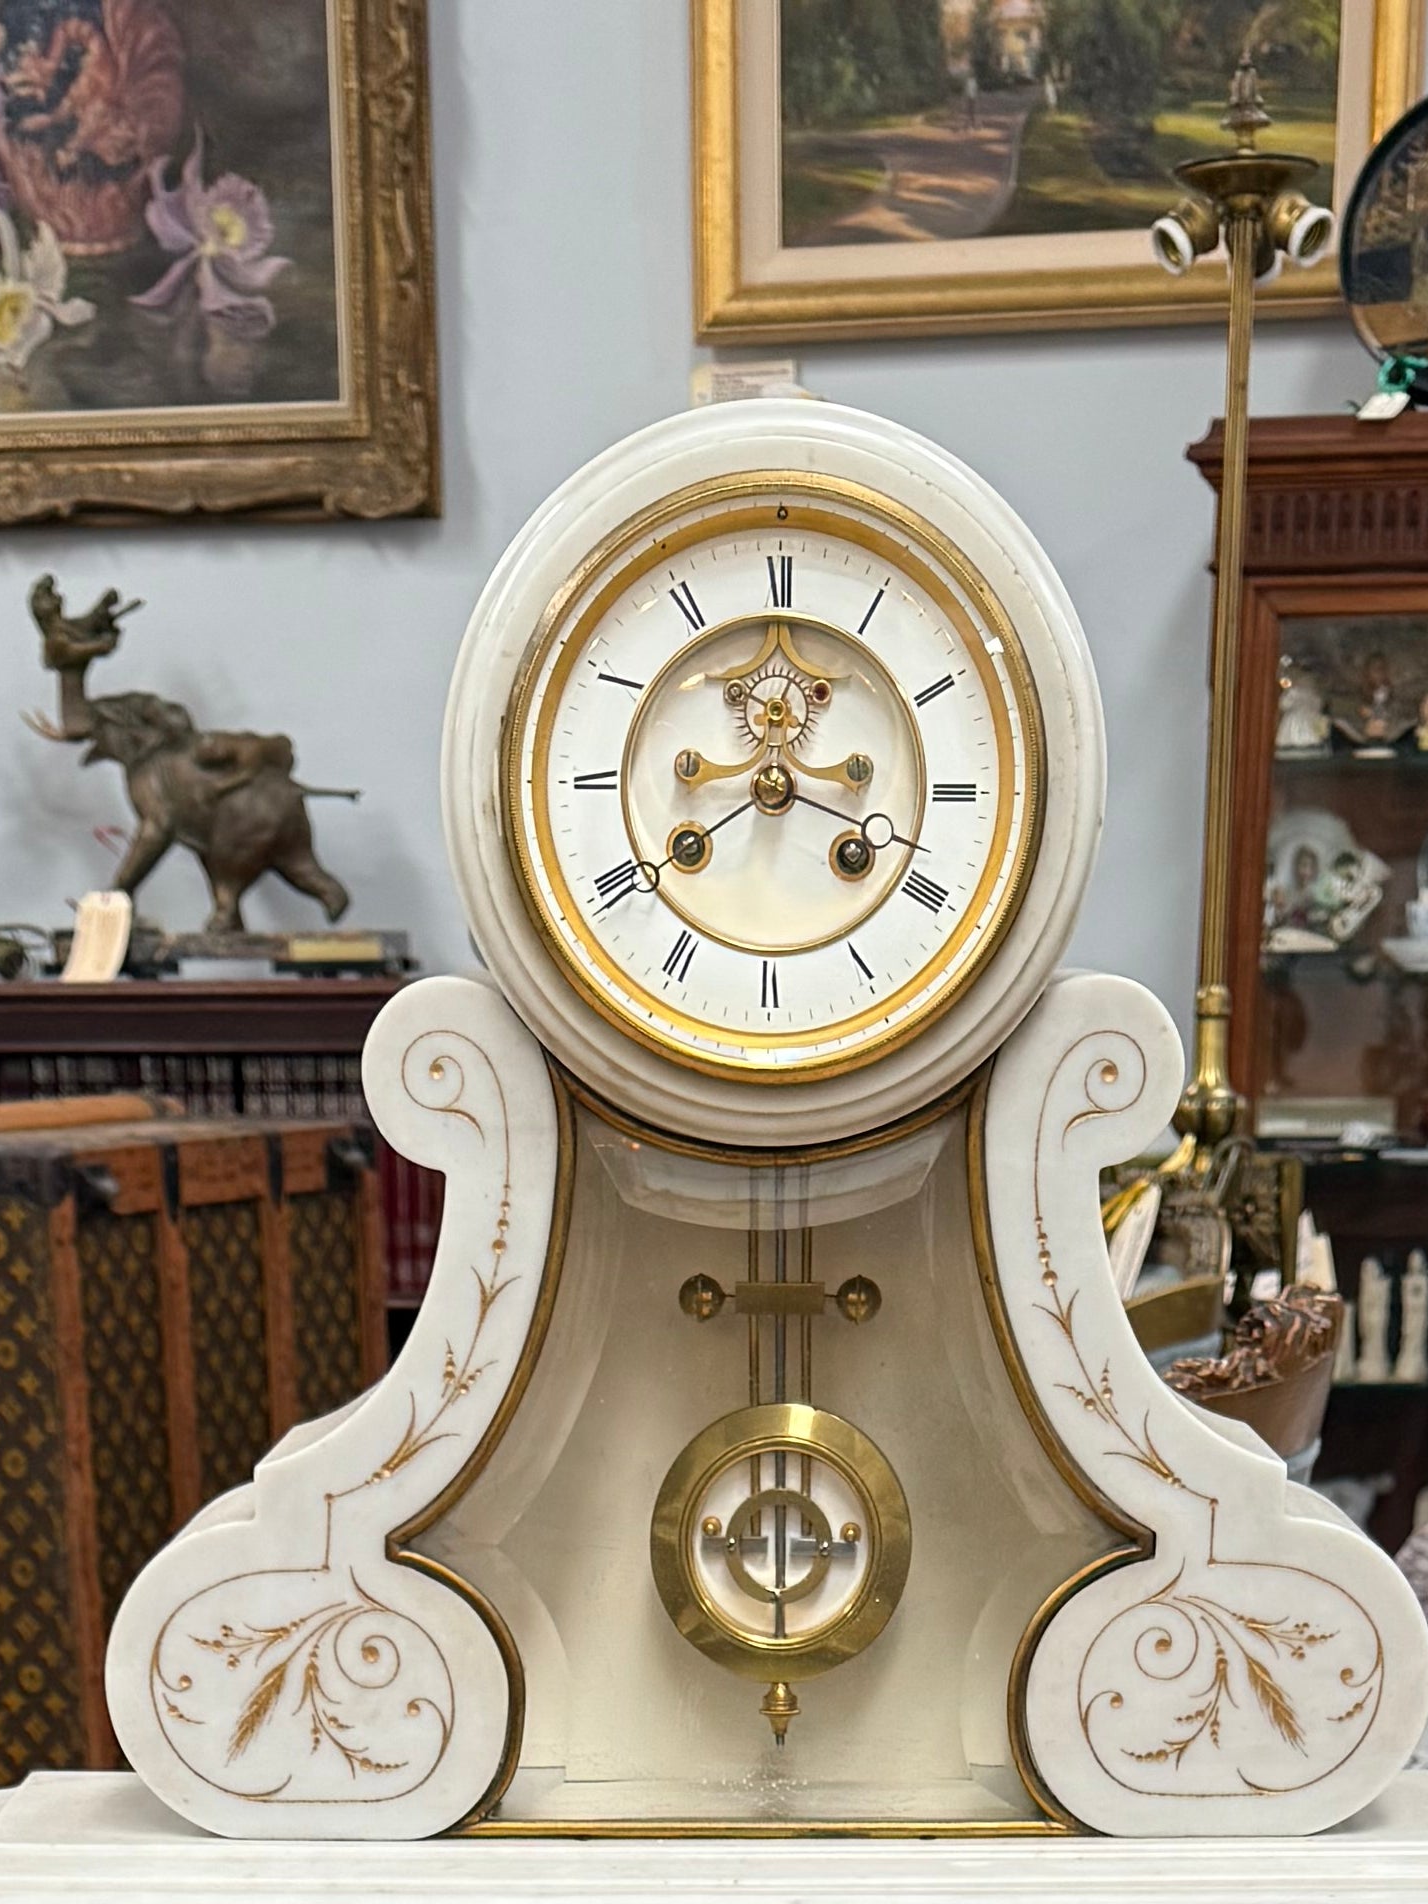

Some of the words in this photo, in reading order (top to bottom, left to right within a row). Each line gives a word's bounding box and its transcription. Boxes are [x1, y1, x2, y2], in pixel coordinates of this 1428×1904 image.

[764, 555, 794, 609] XII
[669, 580, 706, 638] XI
[857, 588, 885, 635] I
[596, 659, 646, 704] X
[913, 673, 956, 708] II
[573, 766, 618, 791] IX
[932, 783, 978, 803] III
[900, 868, 951, 915] IIII
[662, 929, 701, 984] VII
[846, 940, 876, 987] V
[760, 959, 780, 1010] VI
